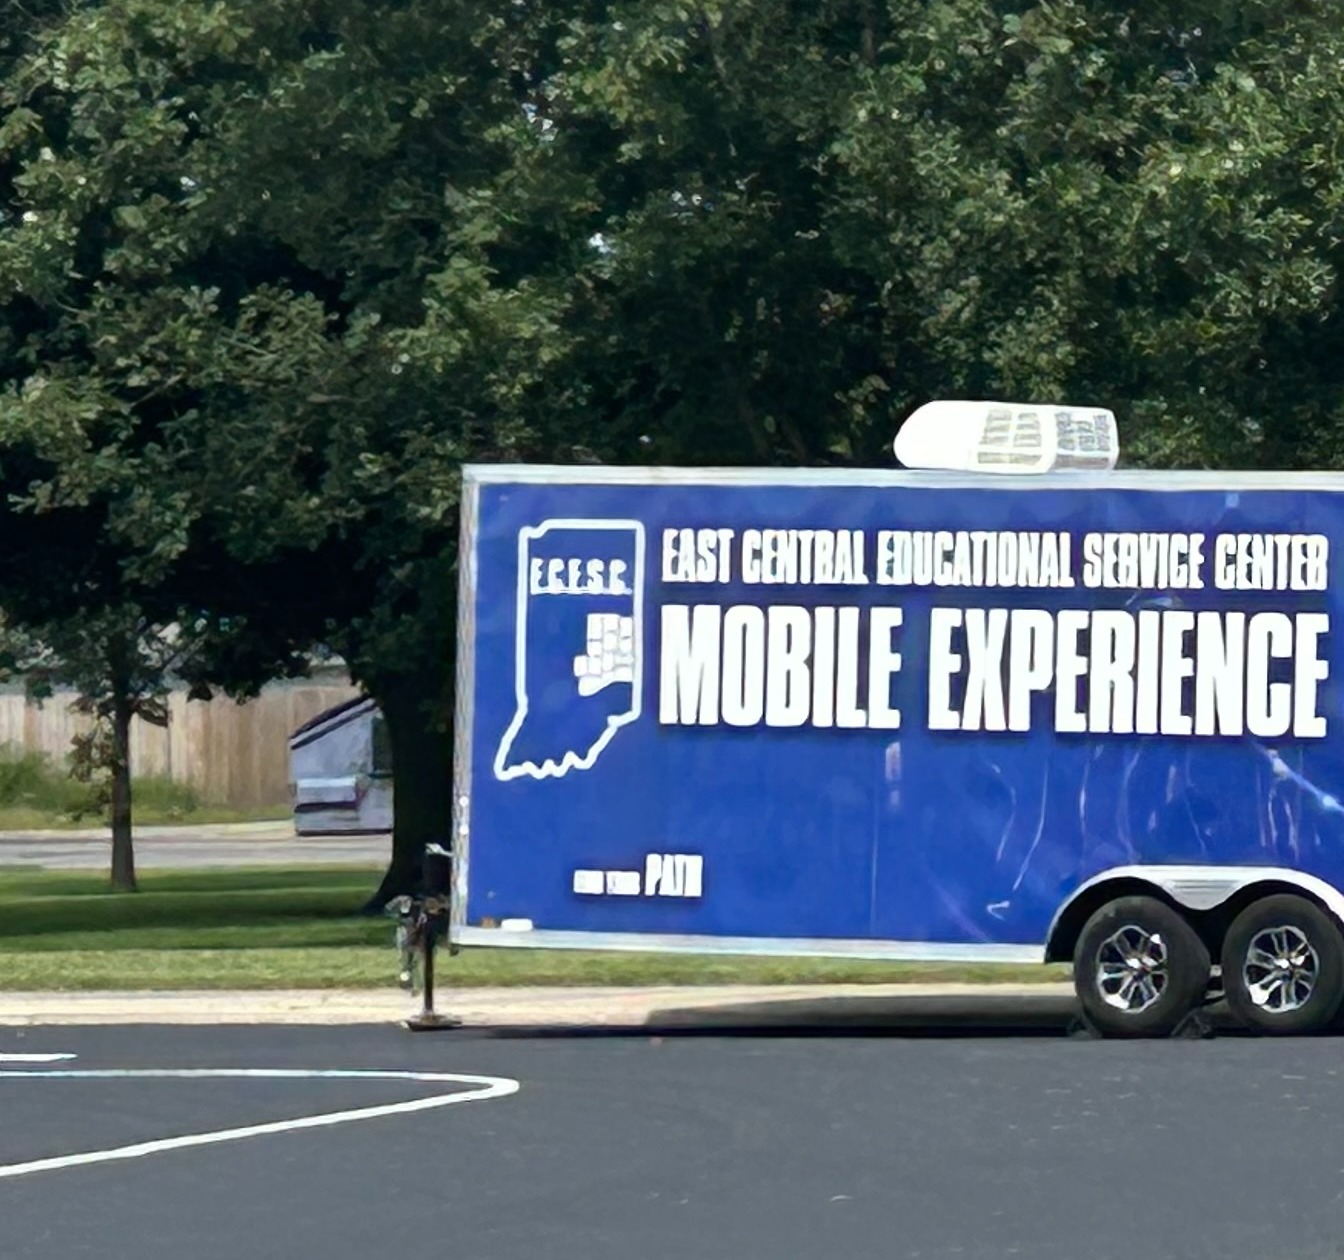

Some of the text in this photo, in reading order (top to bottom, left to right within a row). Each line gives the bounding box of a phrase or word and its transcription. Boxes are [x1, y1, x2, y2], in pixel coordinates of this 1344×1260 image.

[661, 528, 1329, 590] EAST CENTRAL EDUCATIONAL SERVICE CENTER
[659, 604, 902, 729] MOBILE
[928, 606, 1330, 738] EXPERIENCE
